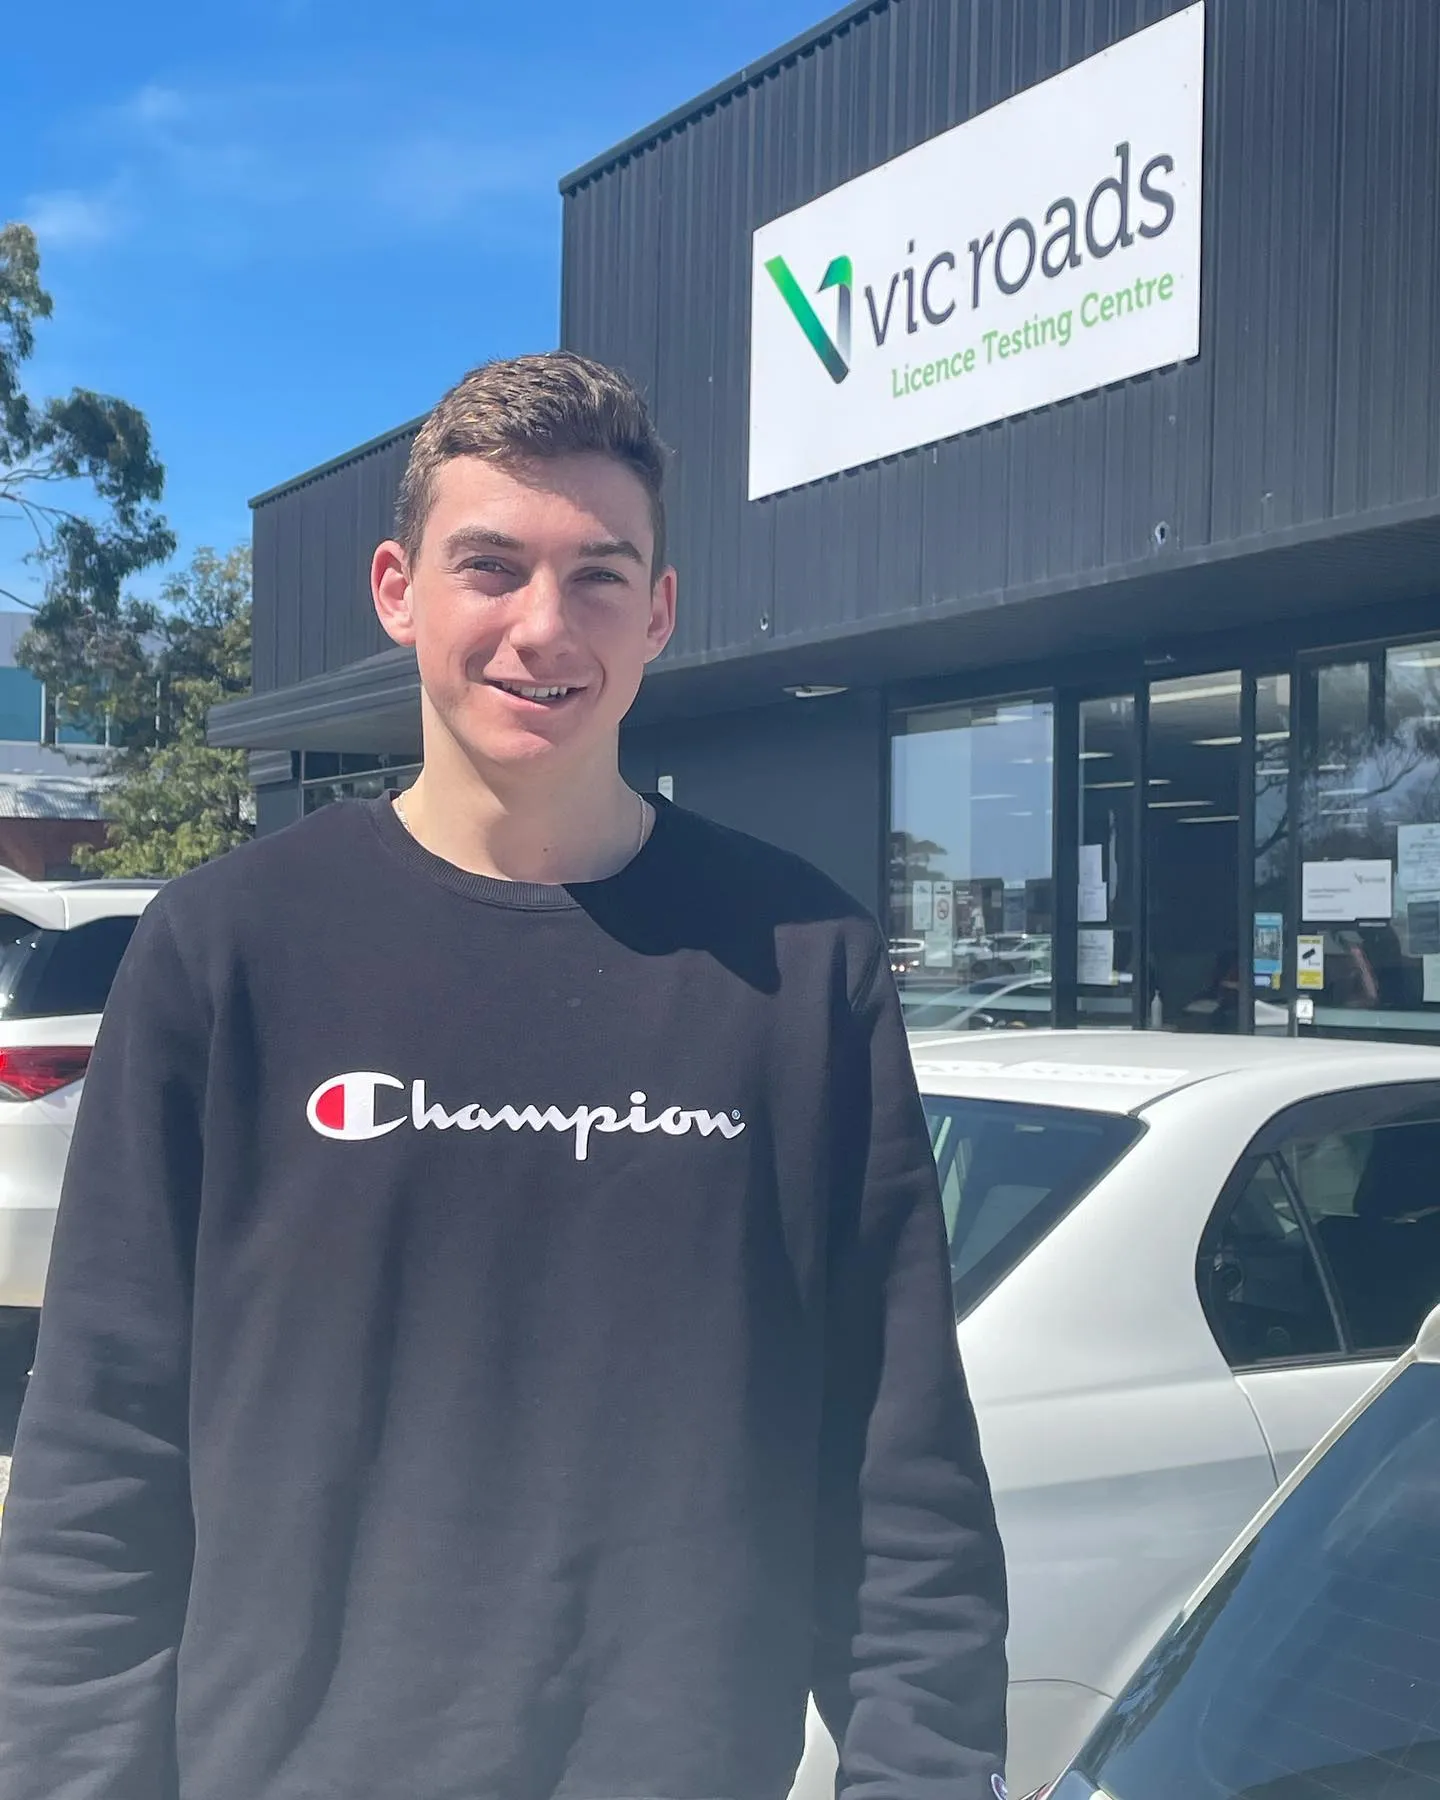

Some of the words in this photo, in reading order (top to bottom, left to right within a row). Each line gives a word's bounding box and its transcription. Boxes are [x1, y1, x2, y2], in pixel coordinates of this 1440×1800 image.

[892, 348, 976, 398] Licence
[982, 310, 1073, 363] Testing
[1081, 272, 1174, 328] Centre
[306, 1071, 746, 1161] Champion
